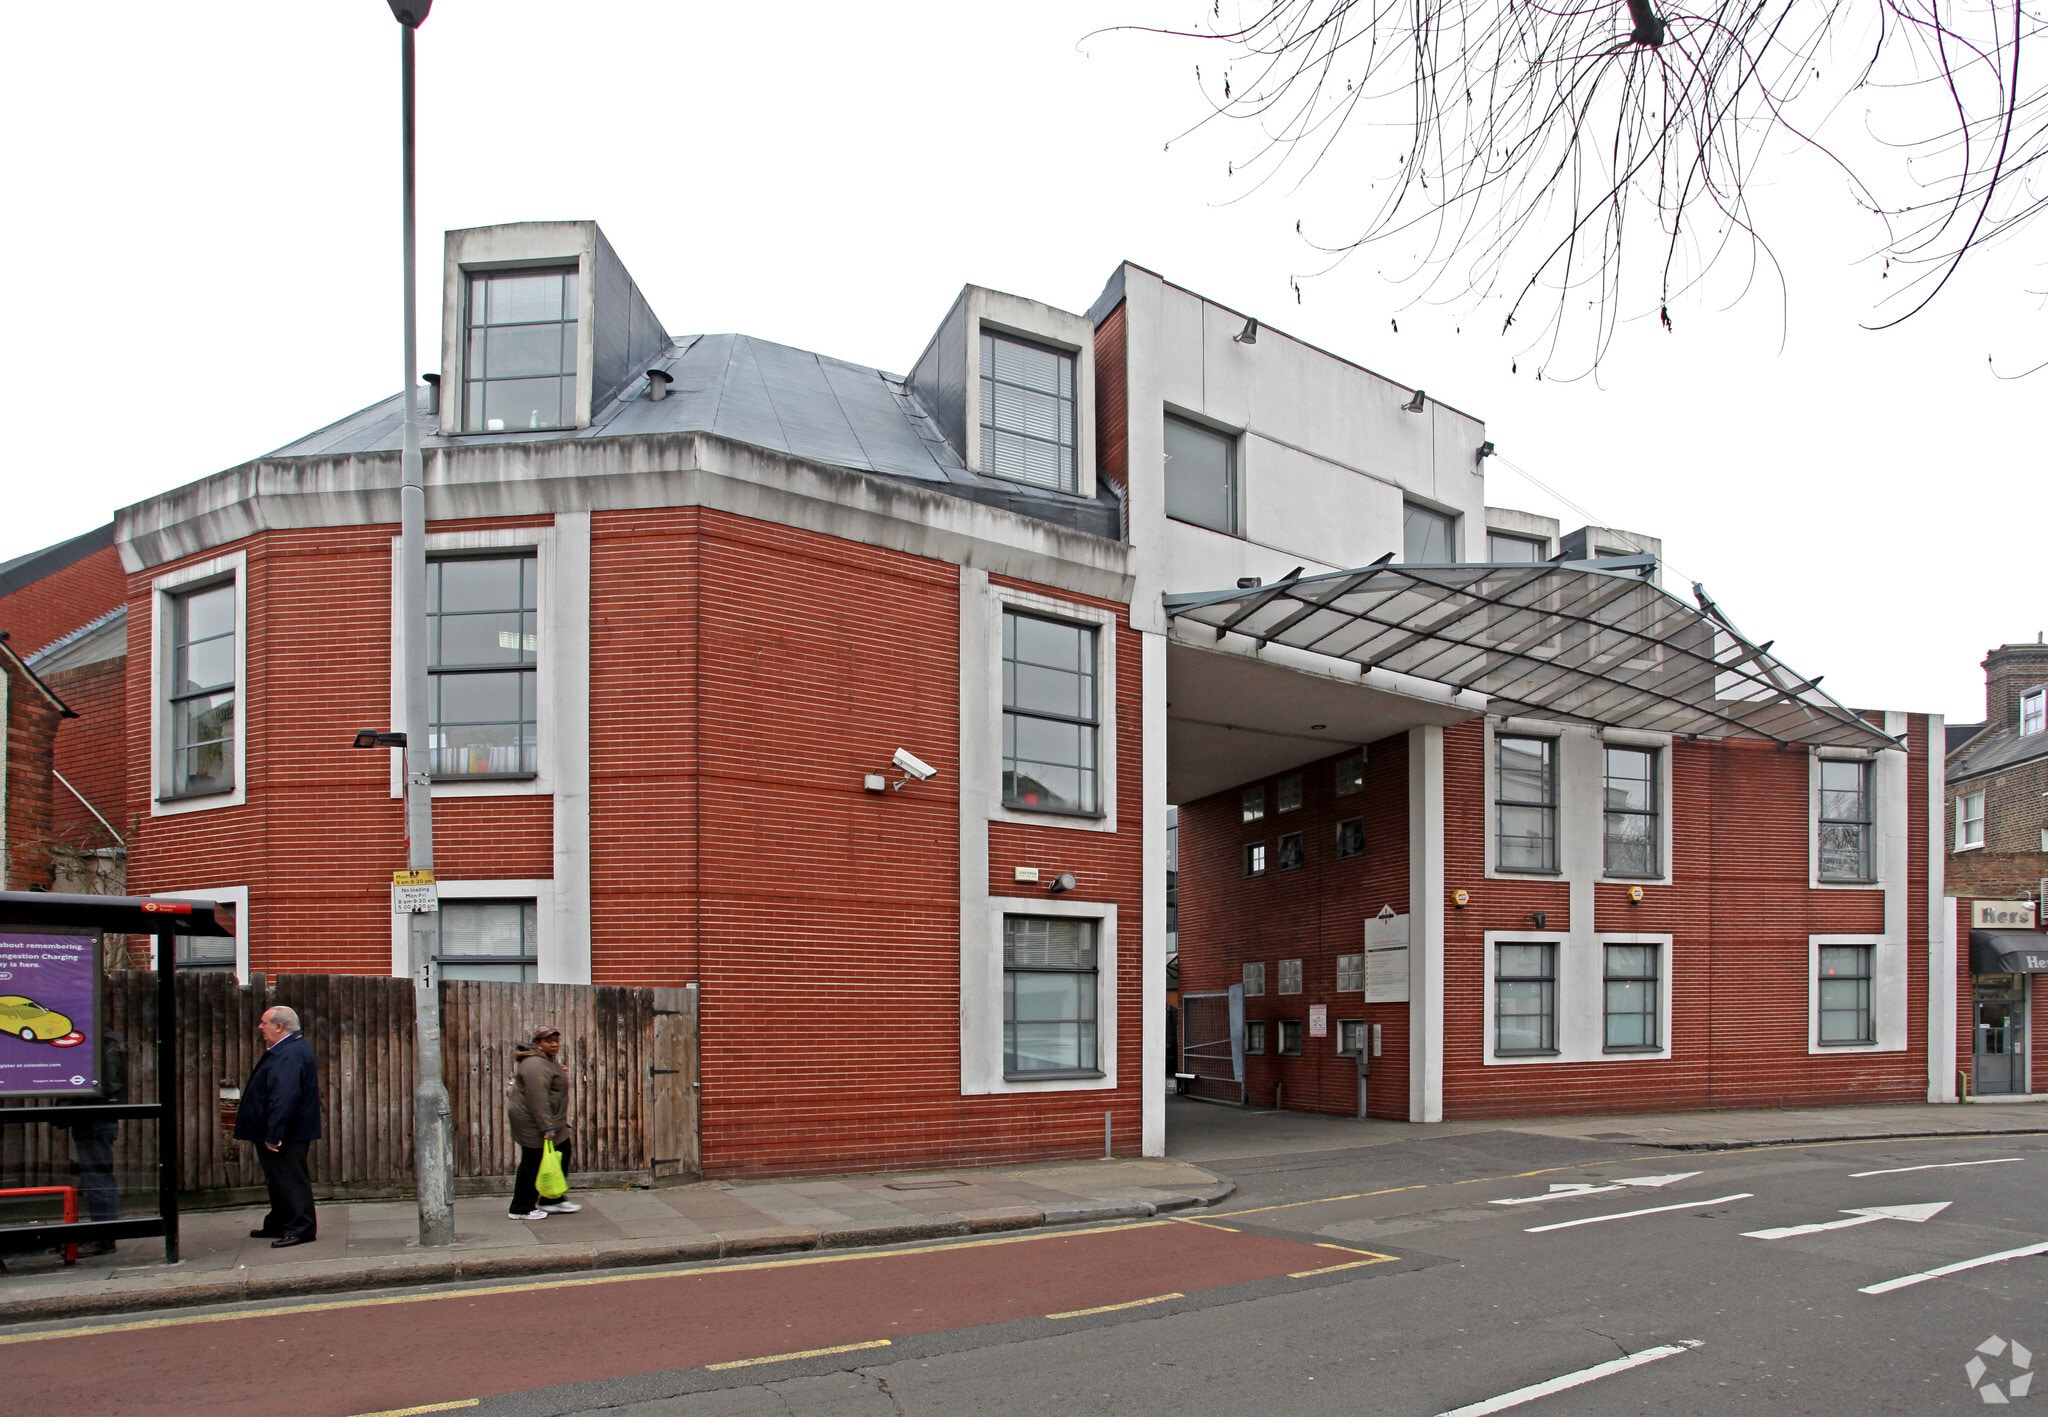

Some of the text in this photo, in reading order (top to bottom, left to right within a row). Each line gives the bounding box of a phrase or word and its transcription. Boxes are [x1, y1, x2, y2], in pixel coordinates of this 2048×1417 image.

[1982, 907, 2029, 923] Hers
[26, 943, 84, 951] remembering.
[41, 953, 79, 961] Charging
